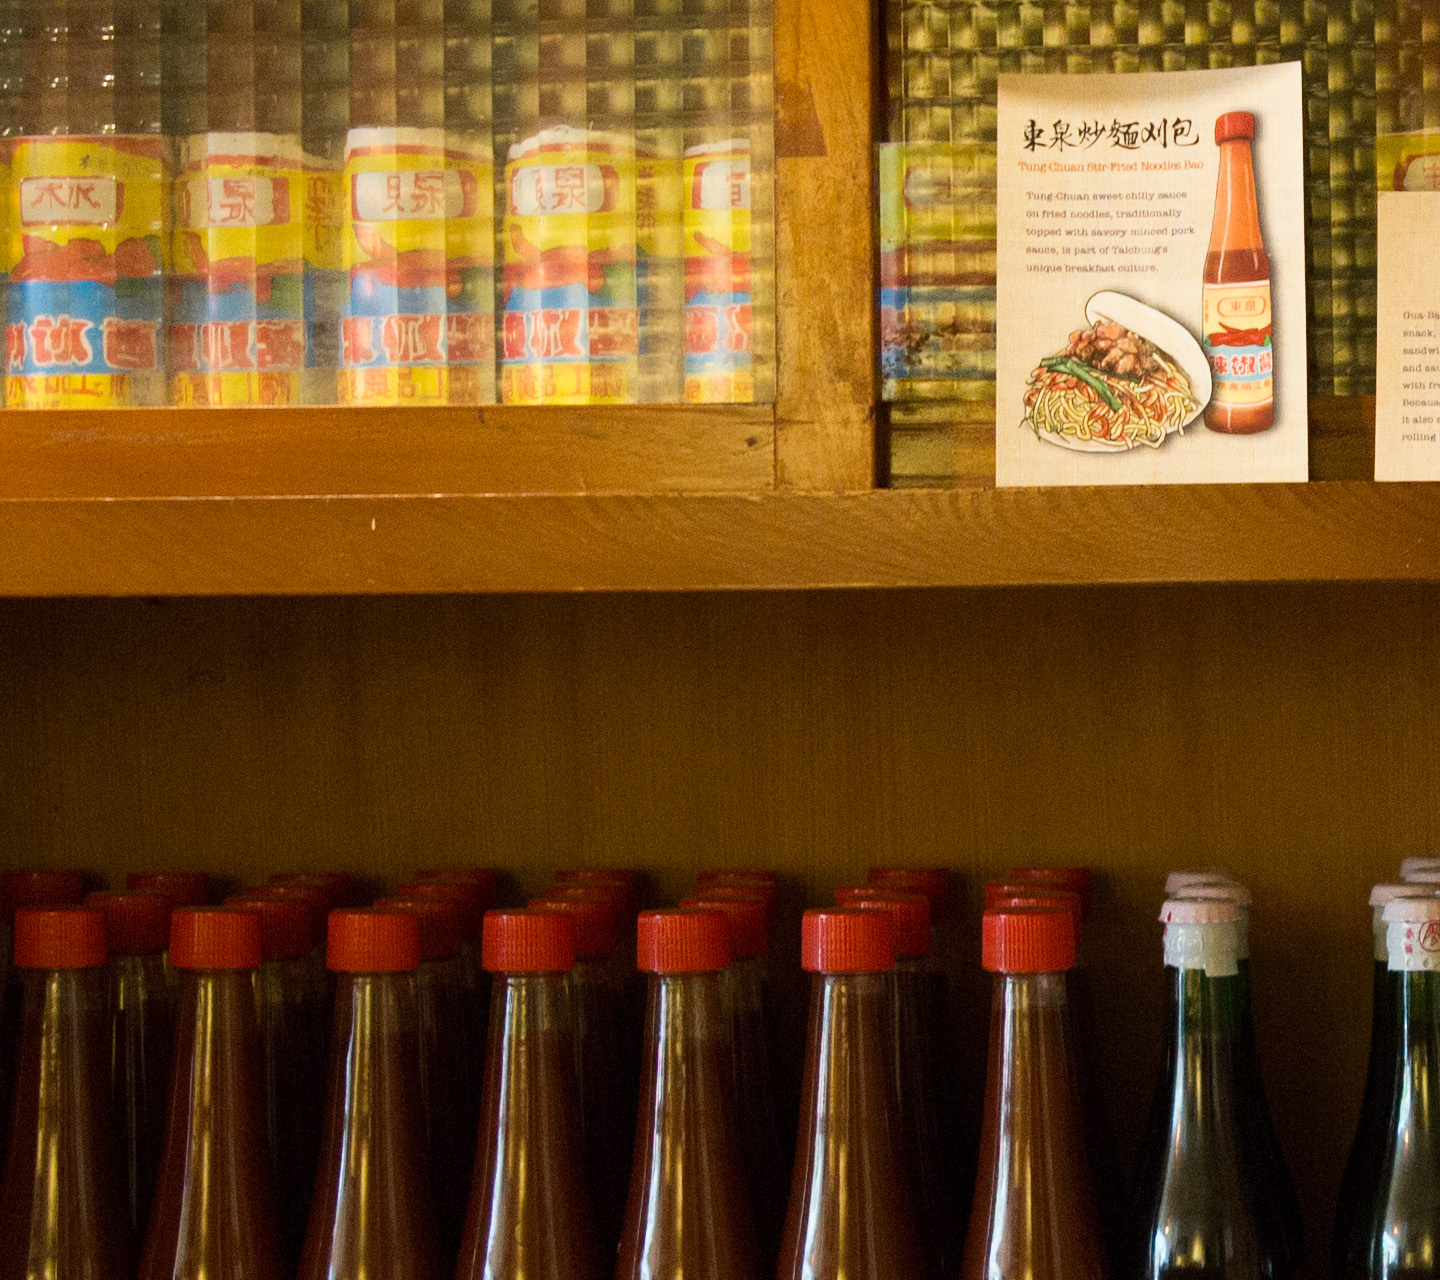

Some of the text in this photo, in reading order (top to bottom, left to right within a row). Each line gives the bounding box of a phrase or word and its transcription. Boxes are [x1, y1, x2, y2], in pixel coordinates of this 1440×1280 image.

[1023, 118, 1199, 151] 東泉炒麵刈包
[1141, 161, 1181, 171] Noodles
[1184, 160, 1203, 170] Bao
[1093, 192, 1123, 200] sweet
[1126, 192, 1154, 201] chilly
[1042, 210, 1067, 218] fried
[1070, 210, 1113, 219] noodles,
[1116, 209, 1182, 219] traditionally
[1026, 227, 1195, 238] topped with savory minced pork
[1026, 247, 1059, 255] sauce,
[1062, 246, 1071, 254] is
[1074, 246, 1096, 255] part
[1099, 246, 1110, 254] of
[1026, 264, 1159, 273] unique breakfast culture.
[1403, 329, 1437, 338] snack,
[1403, 364, 1422, 372] and
[1402, 416, 1410, 424] it
[1412, 416, 1433, 424] also
[1402, 433, 1437, 442] rolling
